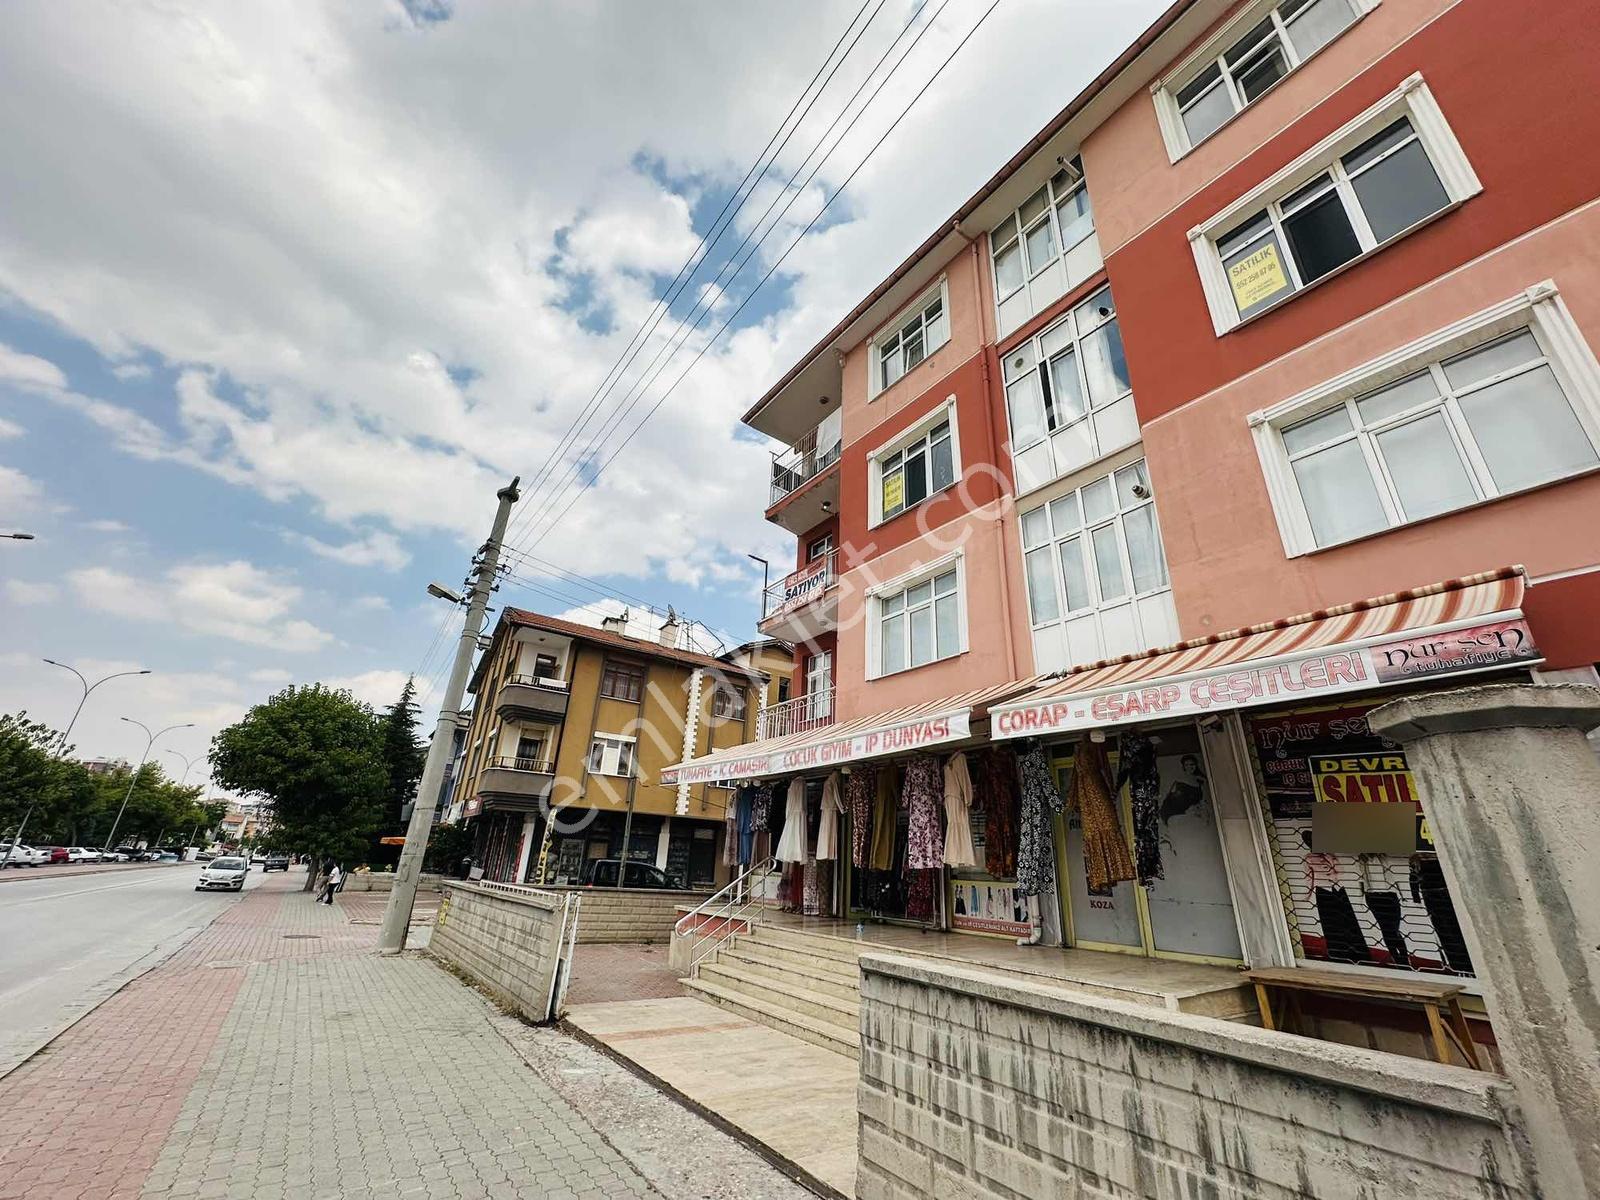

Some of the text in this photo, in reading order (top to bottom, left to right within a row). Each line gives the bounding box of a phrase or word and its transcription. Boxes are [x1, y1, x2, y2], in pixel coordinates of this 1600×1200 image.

[1232, 247, 1272, 277] SATILIK
[784, 570, 826, 601] SATIYOR
[1415, 649, 1513, 673] tuhafiye
[998, 703, 1068, 736] ÇORAP
[1091, 685, 1181, 722] EŞARP
[1319, 757, 1405, 772] DEVR
[1322, 773, 1423, 813] SATIL
[1089, 900, 1115, 910] KOZA
